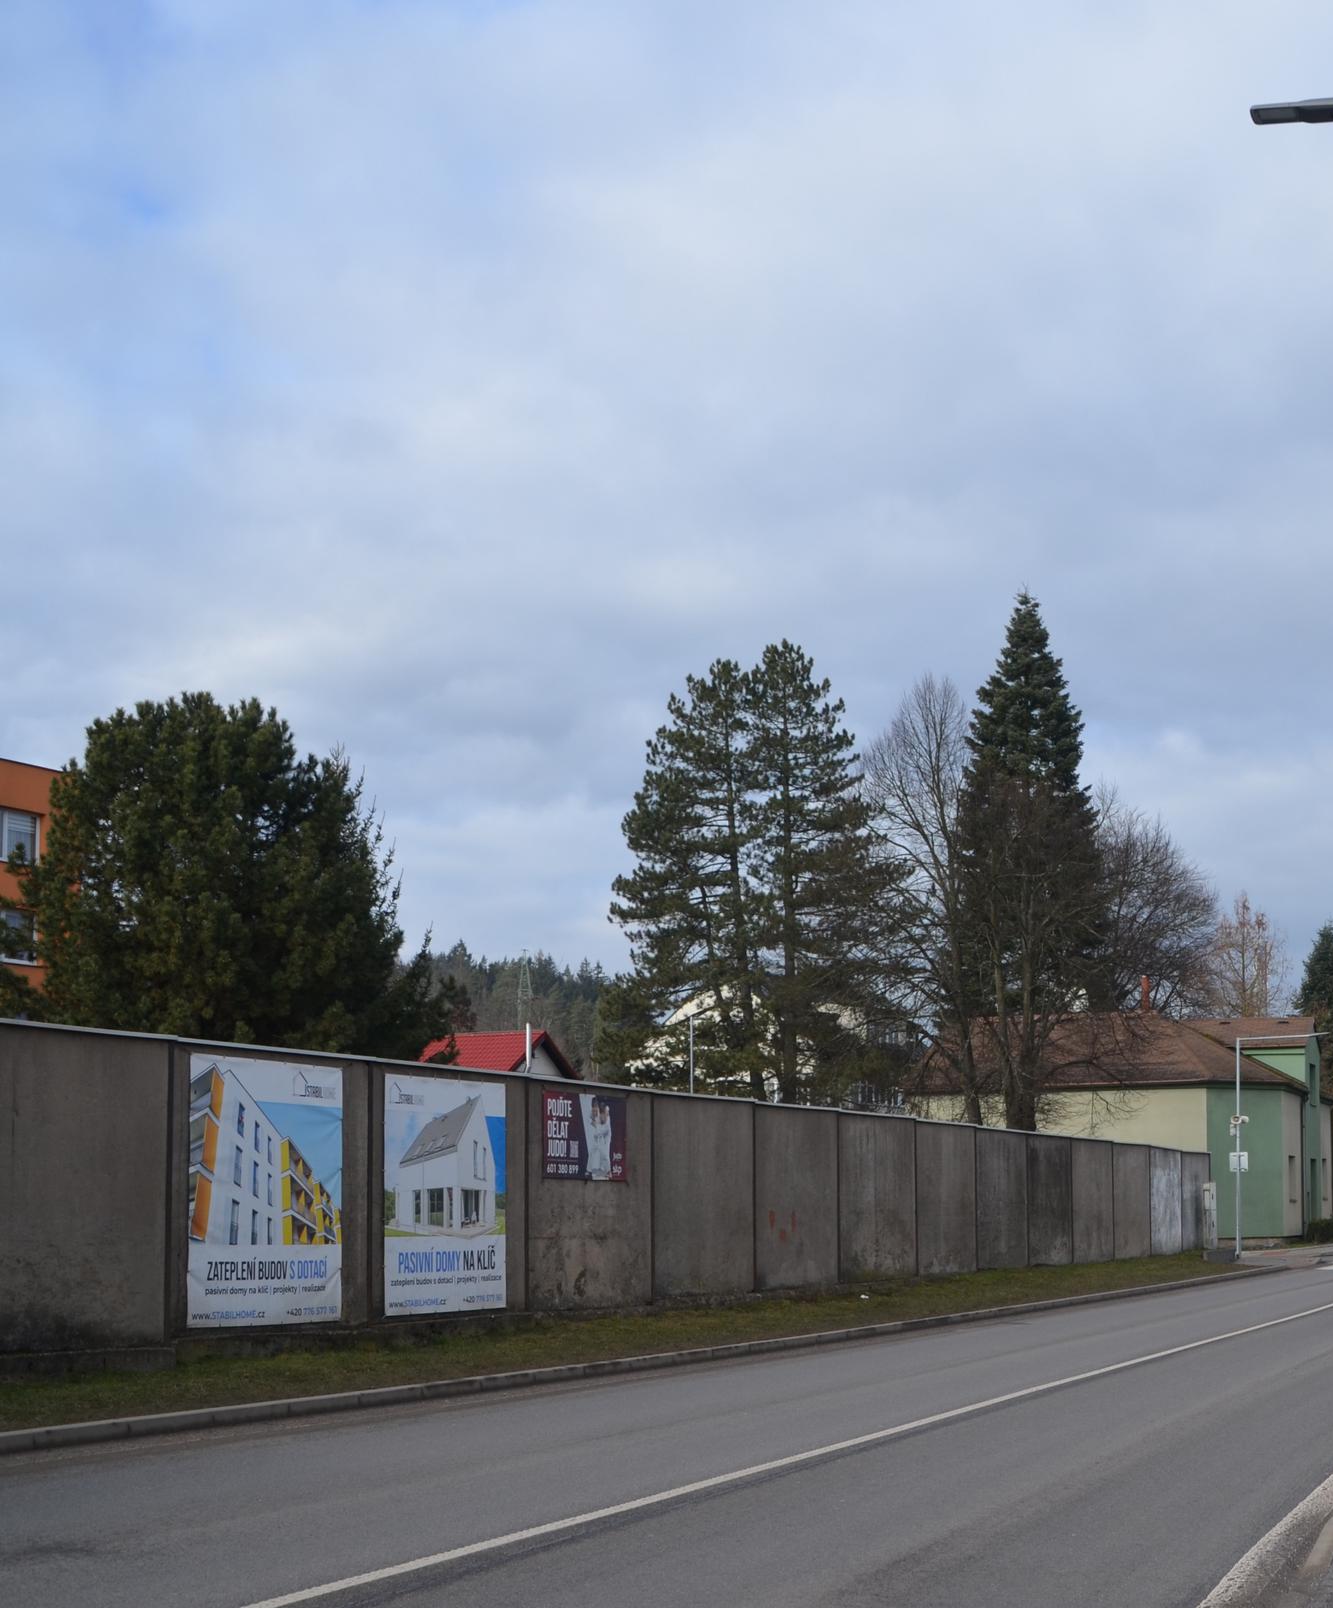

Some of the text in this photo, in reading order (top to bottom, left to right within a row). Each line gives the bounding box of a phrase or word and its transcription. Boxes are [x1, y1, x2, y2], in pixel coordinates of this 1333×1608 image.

[547, 1096, 572, 1117] POJĎTE
[547, 1117, 569, 1138] DĚLAT
[547, 1139, 567, 1157] JUDO!
[546, 1163, 579, 1175] 601 380 899
[207, 1256, 328, 1281] ZATEPLENÍ BUDOV S DOTACÍ
[398, 1245, 496, 1274] PASIVNÍ DOMY NA KLÍČ
[205, 1286, 228, 1296] pasivní
[229, 1286, 247, 1296] domy
[257, 1285, 269, 1294] klíč
[272, 1284, 298, 1295] projekty
[192, 1310, 265, 1320] www.STABILHOME.cz
[286, 1308, 302, 1317] +420
